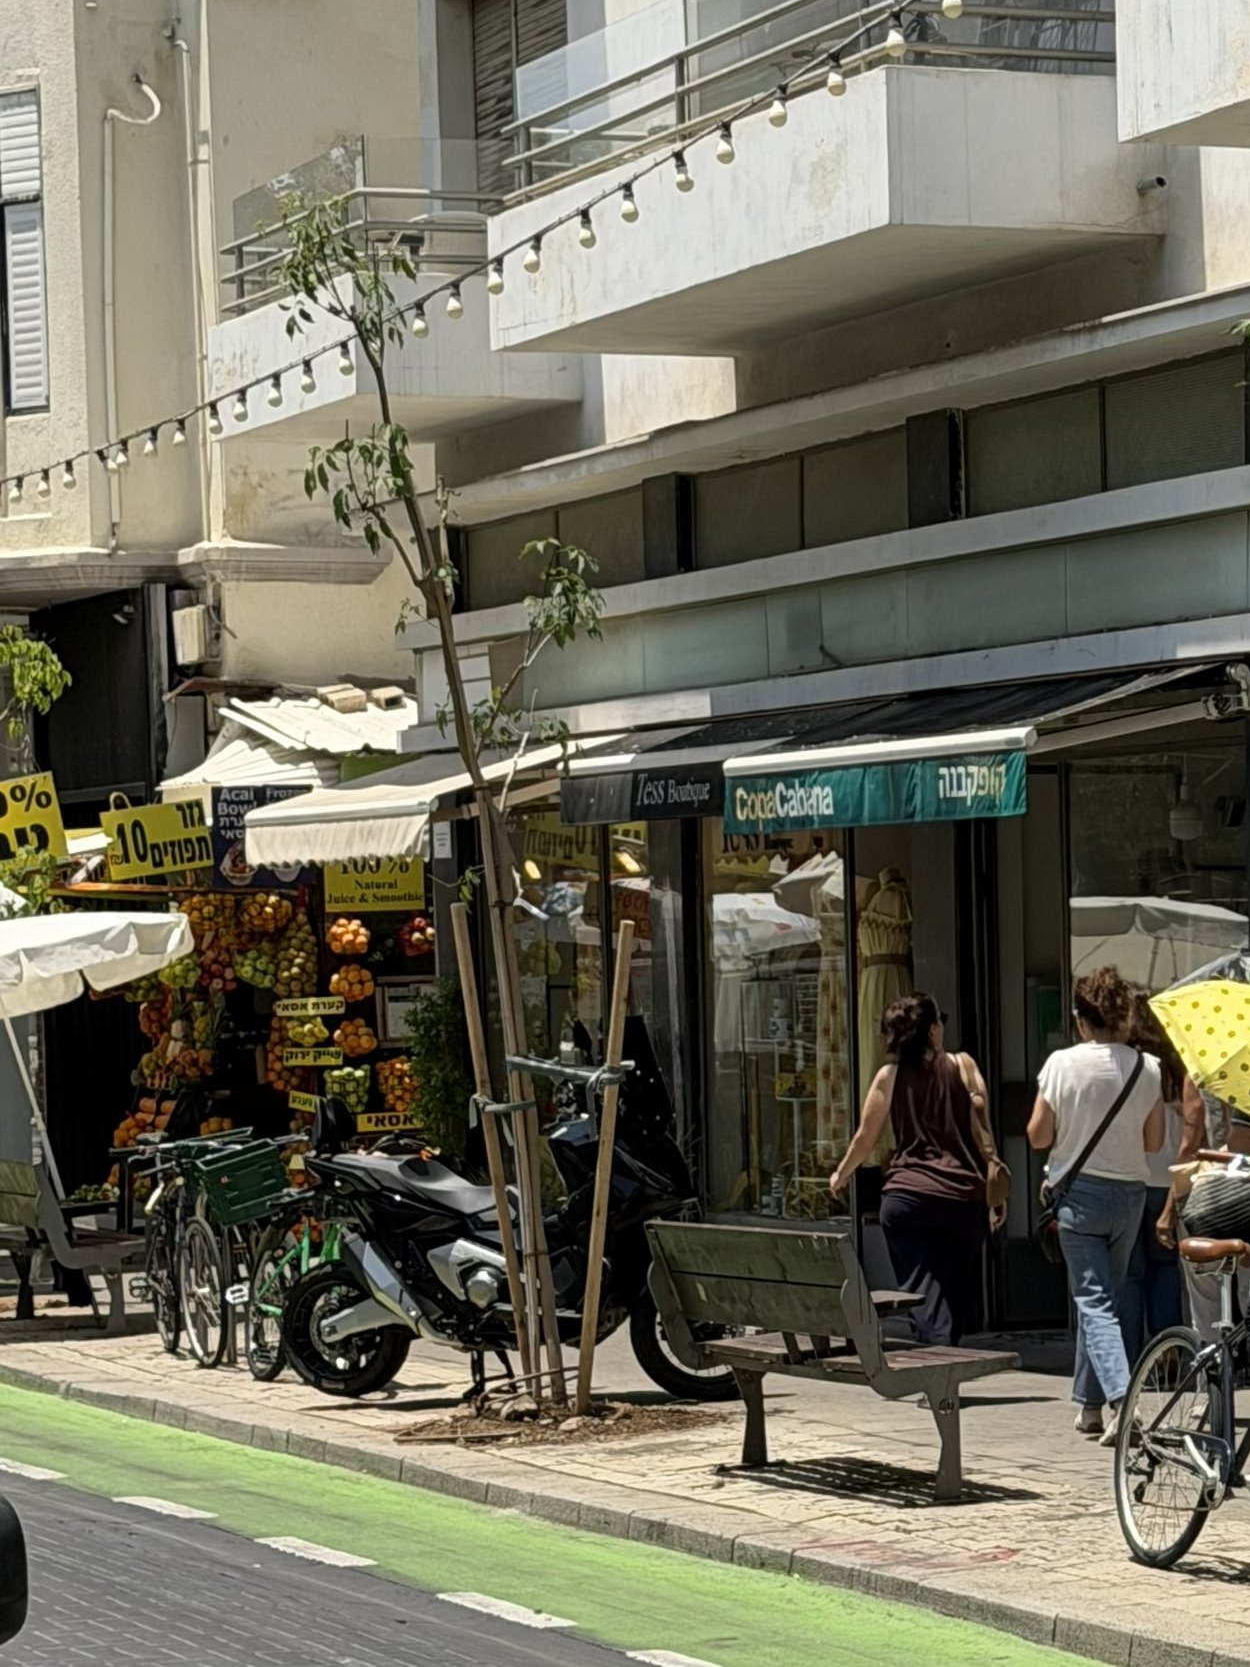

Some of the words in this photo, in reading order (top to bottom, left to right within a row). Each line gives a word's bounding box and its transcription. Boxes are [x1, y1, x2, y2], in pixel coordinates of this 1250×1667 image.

[636, 773, 665, 806] Tess
[151, 835, 210, 868] תפוזים
[354, 878, 398, 890] Natural
[359, 892, 368, 903] &
